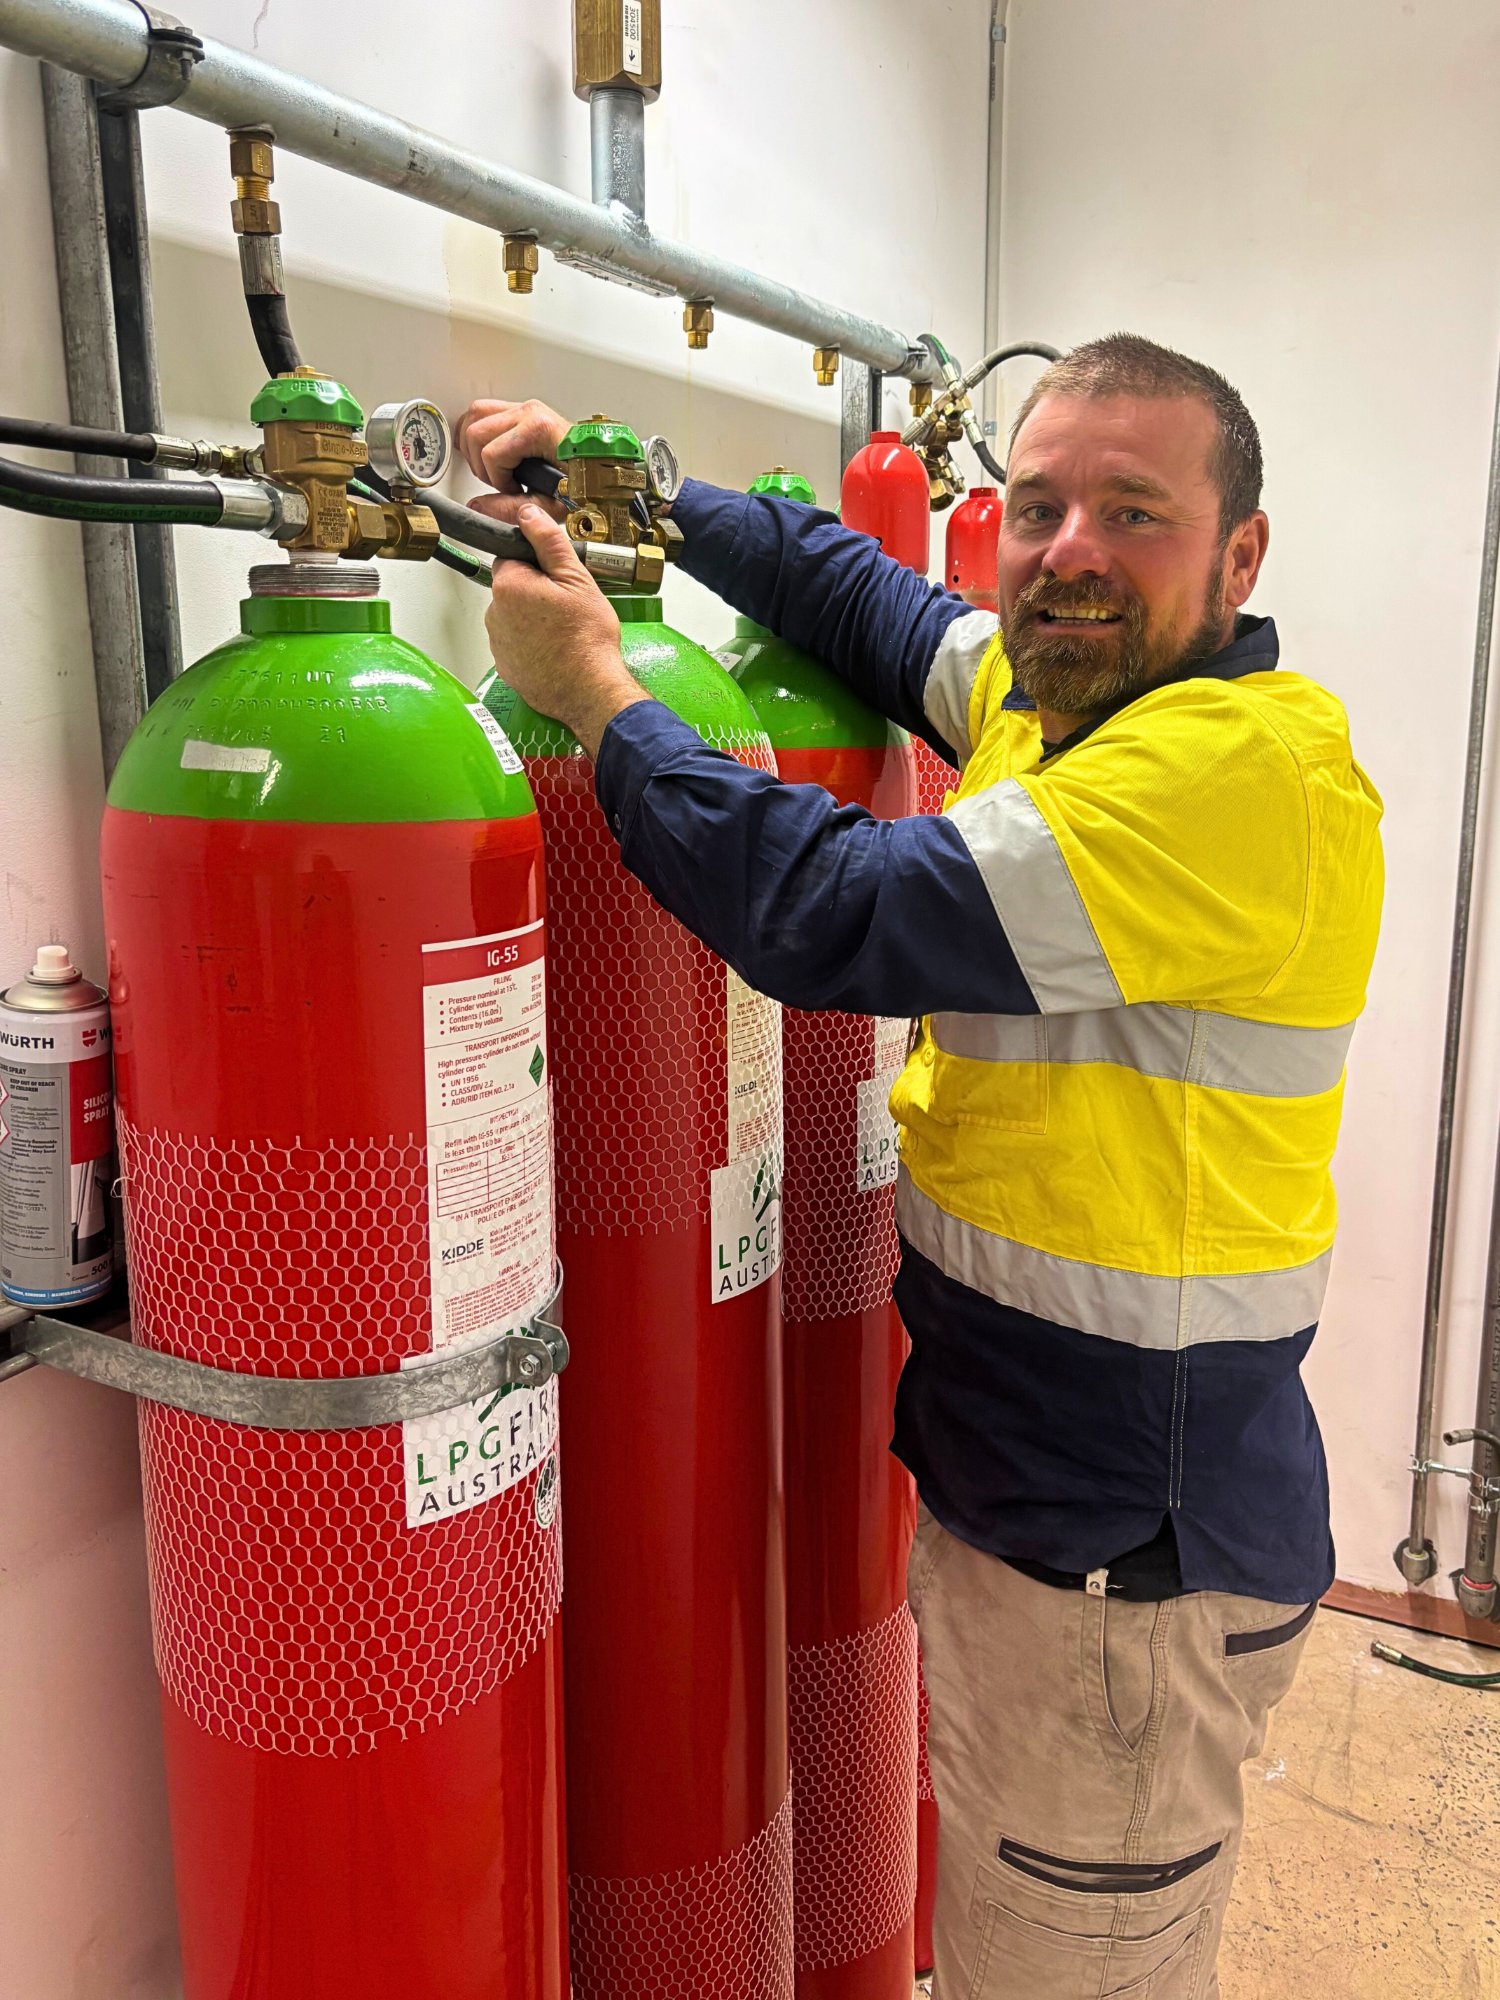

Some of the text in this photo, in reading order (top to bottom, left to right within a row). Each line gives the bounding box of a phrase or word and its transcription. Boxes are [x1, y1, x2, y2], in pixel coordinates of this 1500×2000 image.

[290, 381, 324, 393] OPEN
[487, 945, 518, 967] IG-55
[494, 974, 512, 985] FILLING
[448, 995, 476, 1005] Pressure
[478, 987, 499, 1000] nominal
[449, 999, 497, 1016] Cylinder volume
[449, 1014, 478, 1024] Contents
[449, 1016, 504, 1033] Mixture by volume
[465, 1027, 530, 1052] TRANSPORT INFORMATION
[438, 1060, 454, 1069] High
[455, 1053, 482, 1066] pressure
[483, 1048, 504, 1059] cylinder
[438, 1069, 464, 1079] cylinder
[463, 1075, 479, 1084] 1956
[450, 1080, 494, 1096] CLASS/DIV 2.2
[451, 1095, 478, 1106] ADR/RID
[480, 1090, 493, 1099] ITEM
[504, 1082, 515, 1092] 2.1a
[464, 1135, 477, 1144] with
[442, 1238, 484, 1260] KIDDE
